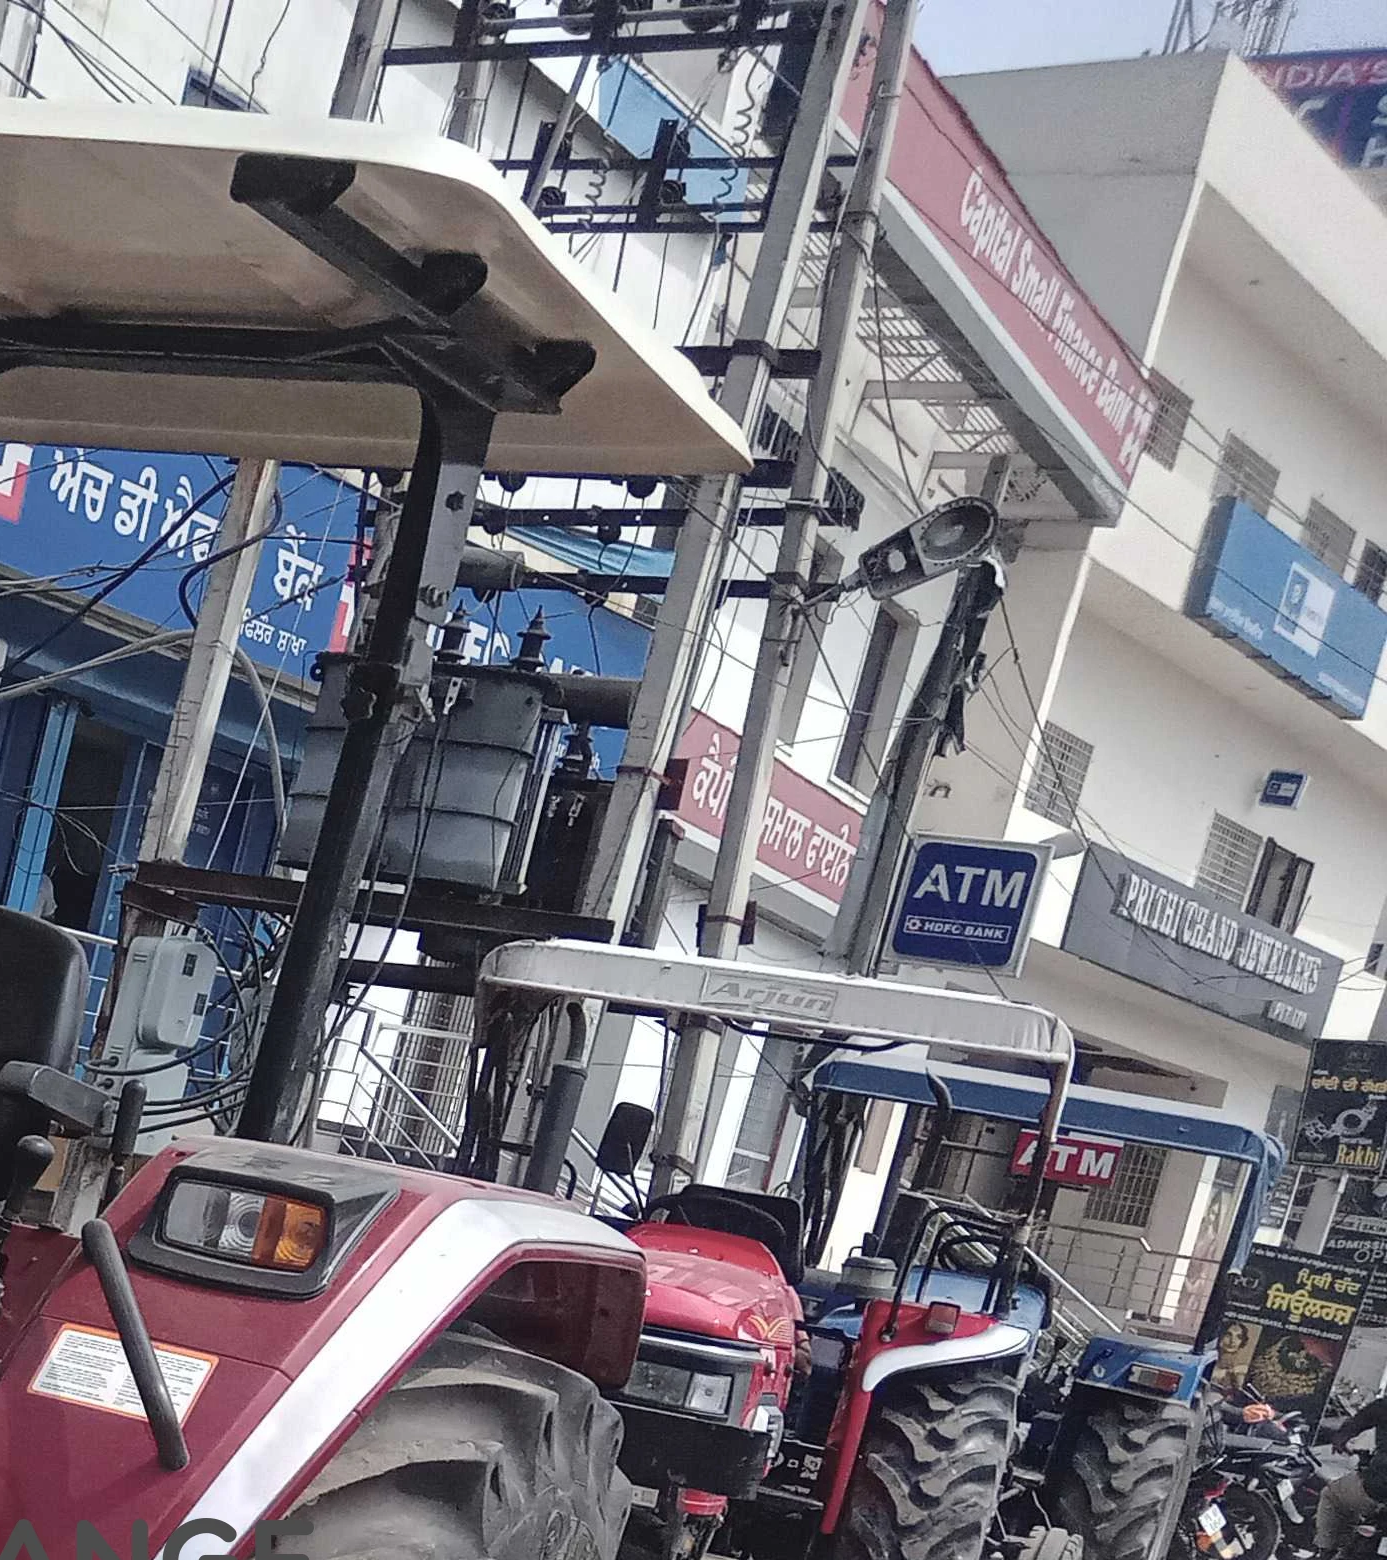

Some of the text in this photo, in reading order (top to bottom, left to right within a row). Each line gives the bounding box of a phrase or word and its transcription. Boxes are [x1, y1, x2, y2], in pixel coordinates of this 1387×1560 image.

[960, 166, 1022, 281] Capital
[1011, 238, 1061, 324] Small
[1053, 292, 1104, 396] Finance
[912, 863, 1028, 909] ATM
[923, 920, 1005, 939] HDFC BANK
[1125, 873, 1323, 996] PRITHI CHAND JEWELLERS
[710, 982, 832, 1012] Arjun
[1016, 1138, 1116, 1180] ATM
[1336, 1143, 1380, 1167] Rakhi
